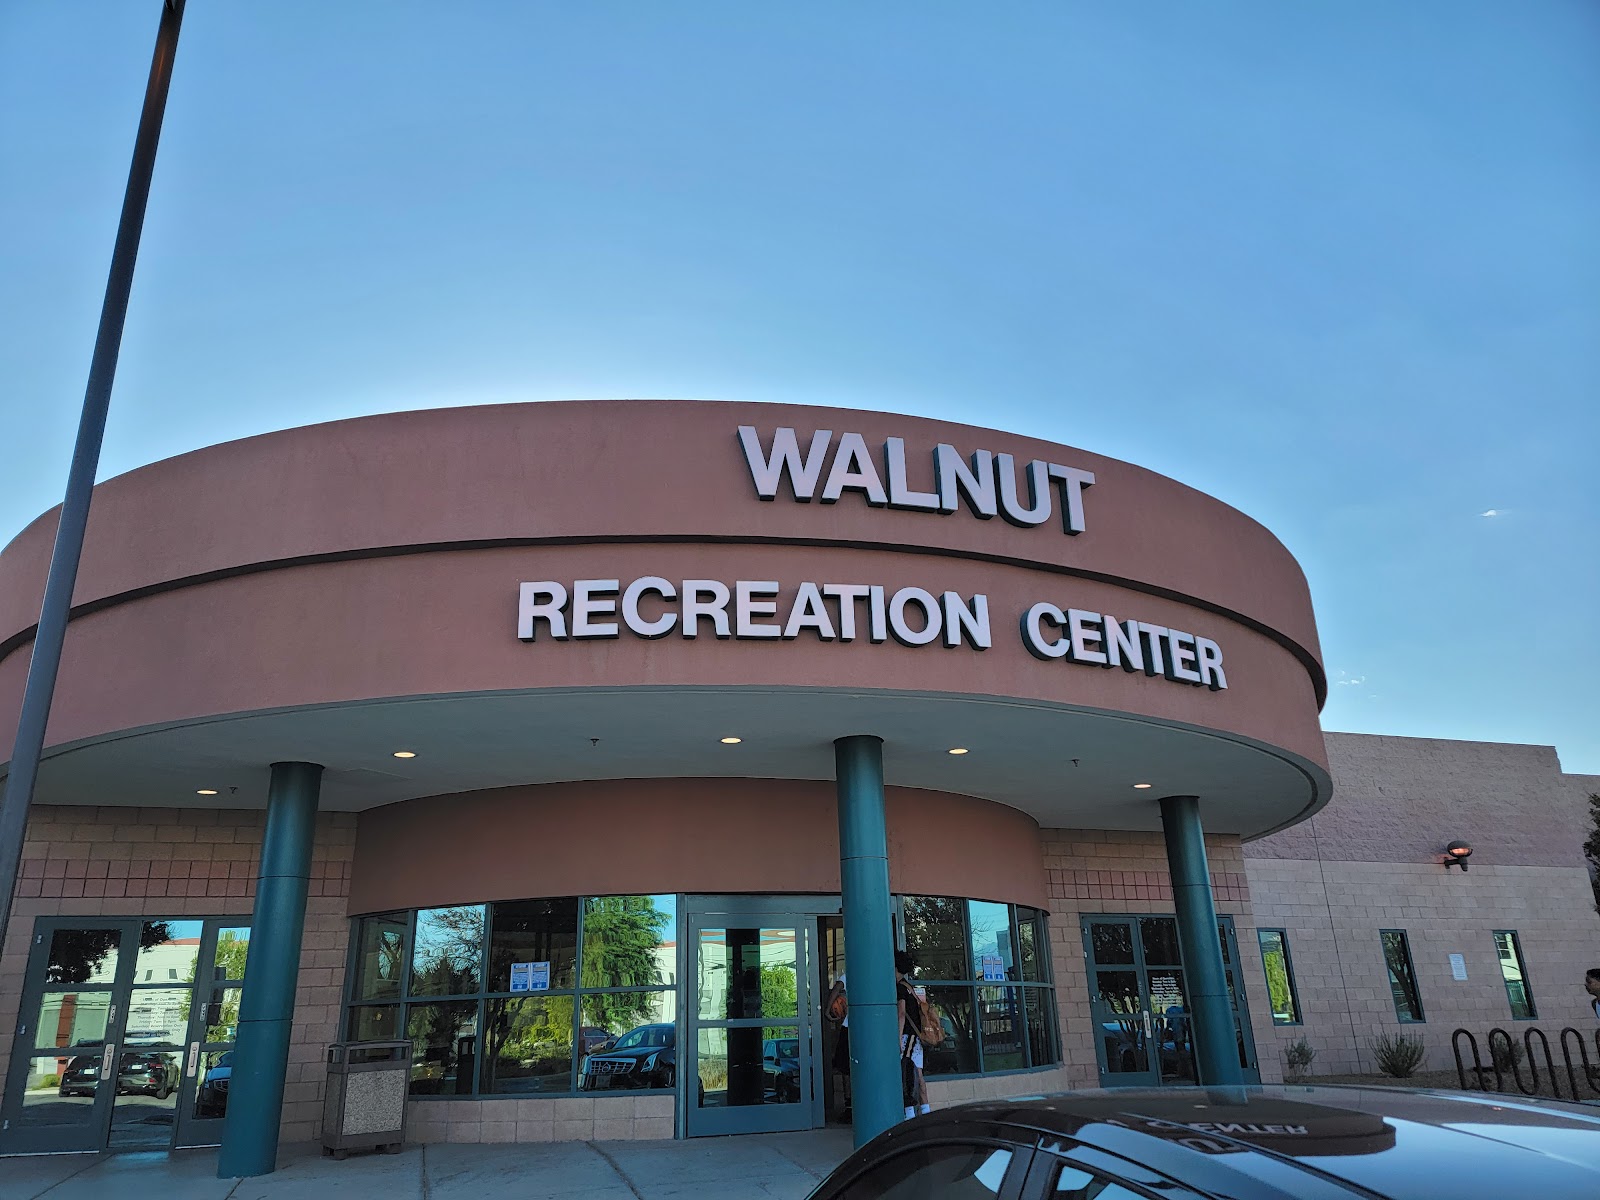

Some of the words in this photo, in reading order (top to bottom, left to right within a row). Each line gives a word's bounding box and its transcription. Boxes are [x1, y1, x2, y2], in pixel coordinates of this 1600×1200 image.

[737, 425, 1095, 535] WALNUT
[517, 575, 992, 649] RECREATION
[1020, 602, 1228, 691] CENTER
